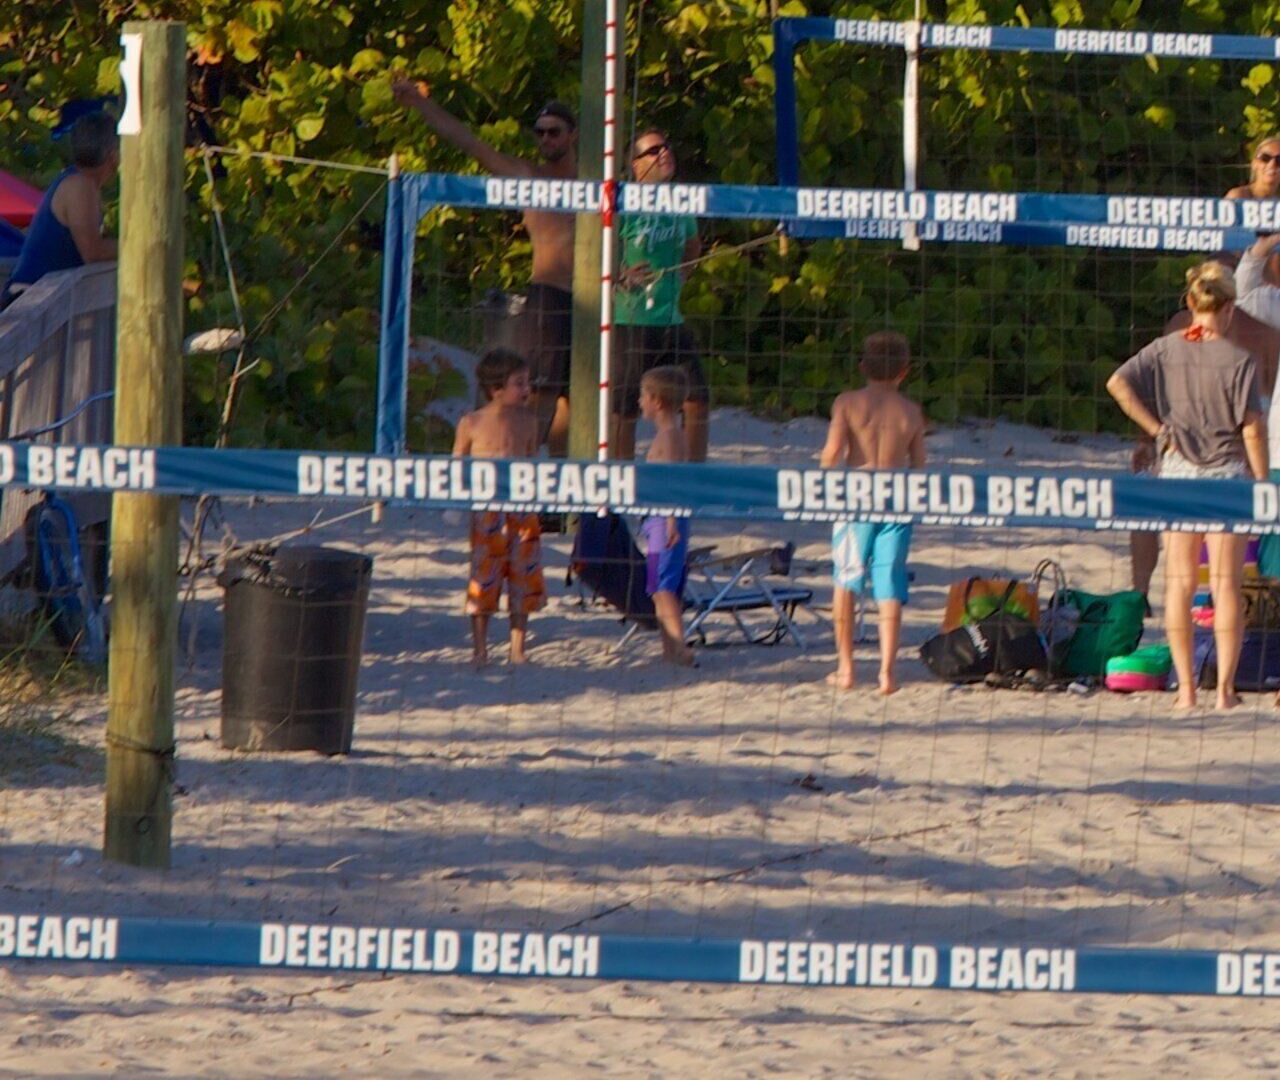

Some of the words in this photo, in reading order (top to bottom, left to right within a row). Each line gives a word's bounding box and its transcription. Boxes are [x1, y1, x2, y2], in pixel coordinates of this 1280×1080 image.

[835, 20, 928, 45] DEERFIE
[931, 24, 992, 47] BEACH
[1055, 29, 1149, 54] DEERFIELD
[1151, 33, 1212, 56] BEACH
[486, 178, 615, 210] DEERFIEL
[623, 183, 707, 214] BEACH
[797, 189, 927, 221] DEERFIELD
[934, 192, 1017, 222] BEACH
[1107, 197, 1236, 228] DEERFIELD
[943, 222, 1003, 246] BEACH
[1067, 225, 1160, 248] DEERFIELD
[1163, 227, 1224, 251] BEACH
[28, 445, 155, 489] BEACH
[298, 456, 497, 500] DEERFIELD
[509, 462, 635, 505] BEACH
[777, 470, 975, 513] DEERFIELD
[987, 476, 1113, 518] BEACH
[0, 915, 118, 958] BEACH
[260, 924, 460, 973] DEERFIELD
[472, 931, 599, 976] BEACH
[739, 940, 938, 988] DEERFIELD
[950, 946, 1076, 990] BEACH
